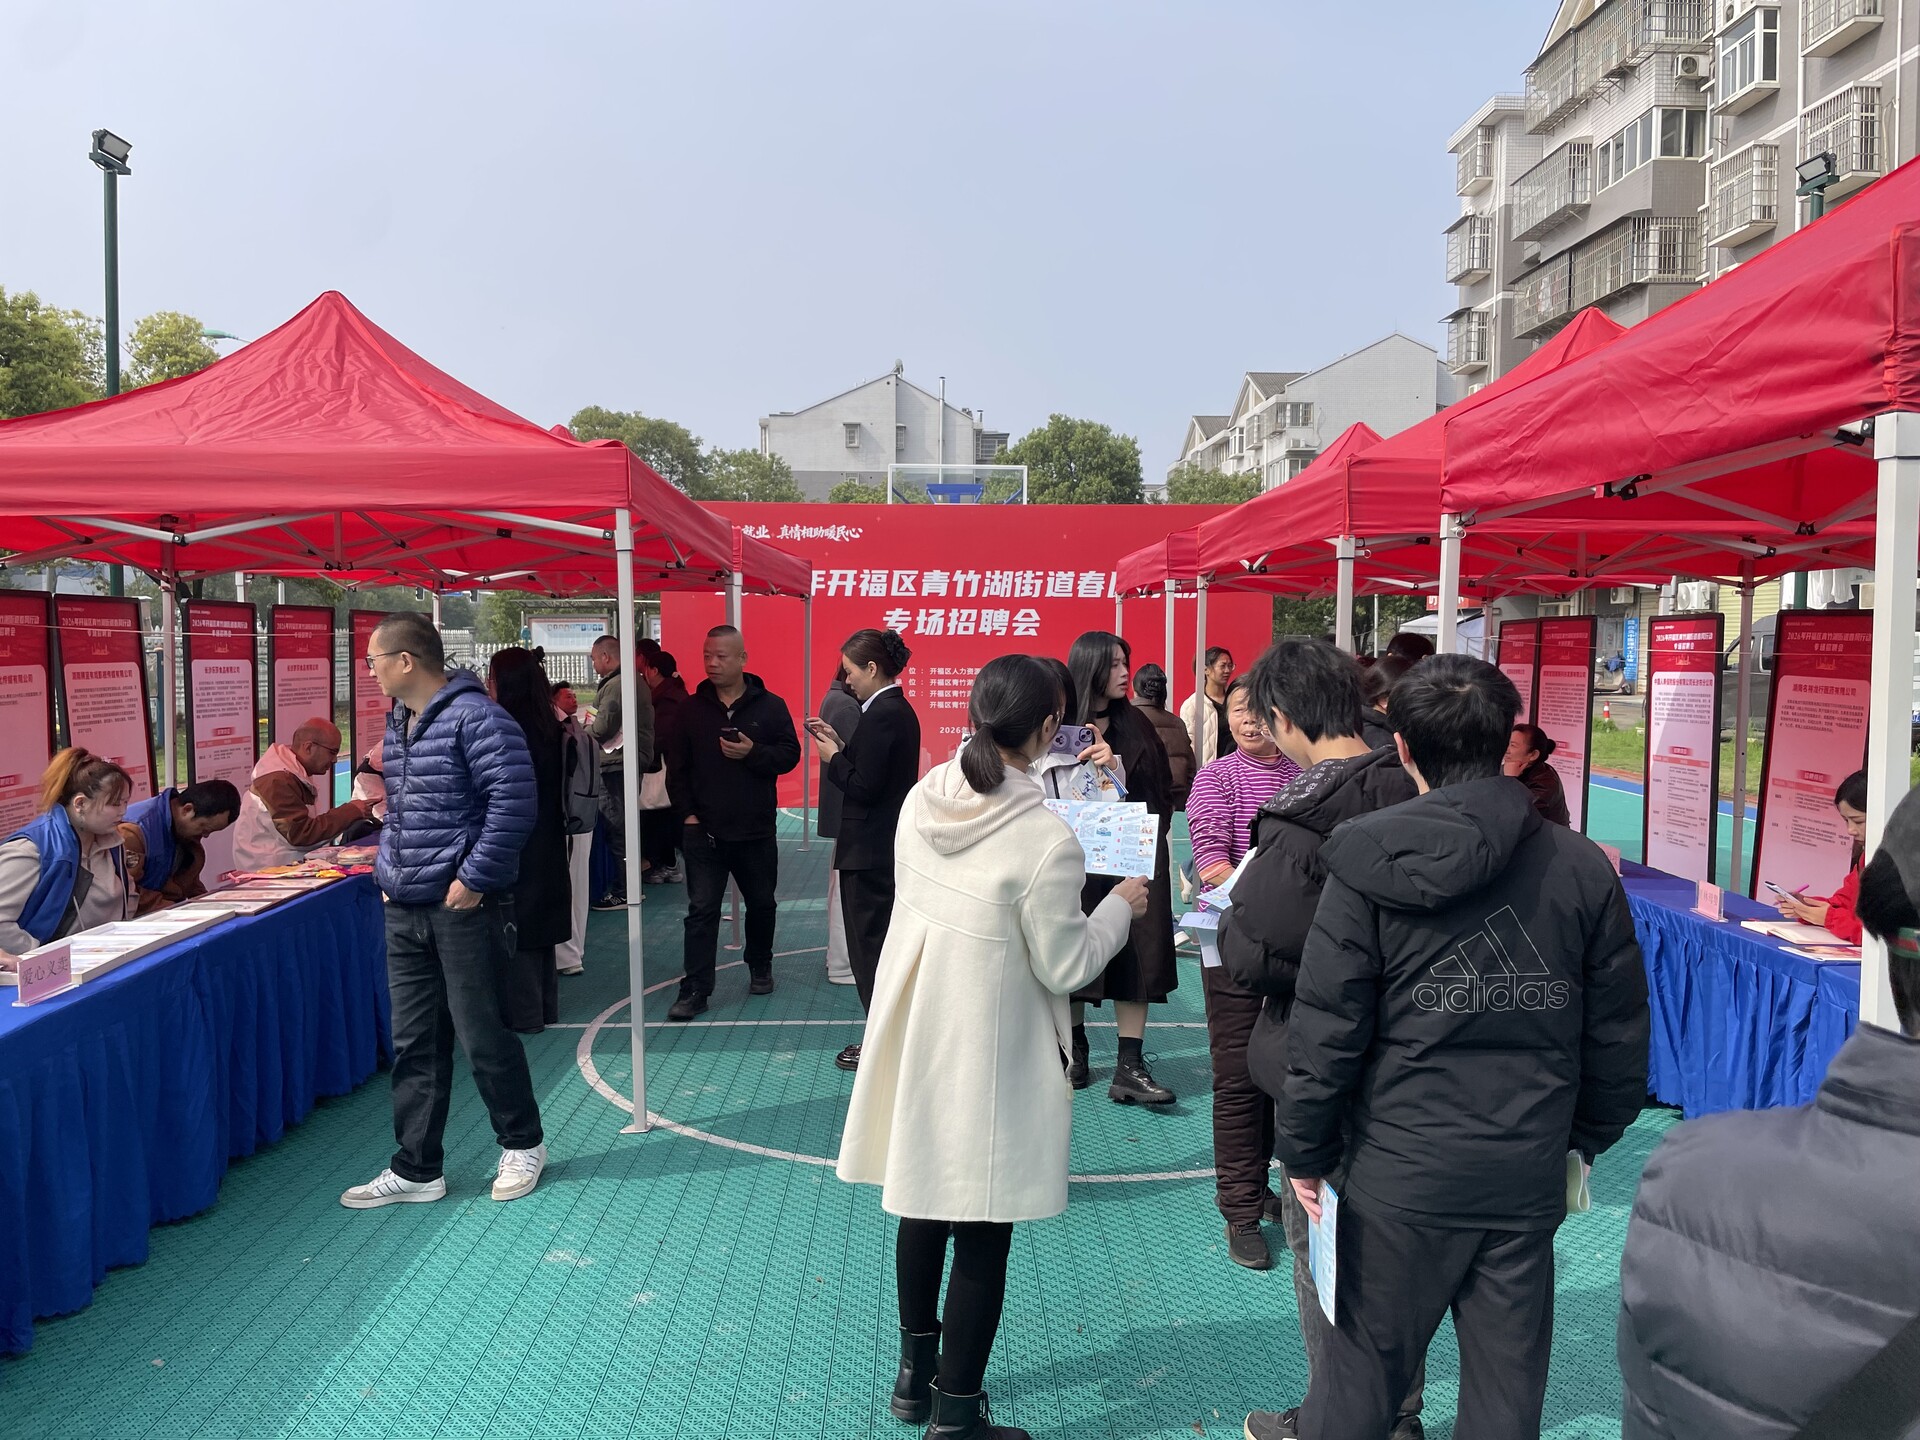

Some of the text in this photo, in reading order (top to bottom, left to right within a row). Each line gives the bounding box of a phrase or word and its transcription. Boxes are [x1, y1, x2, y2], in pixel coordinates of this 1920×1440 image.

[777, 525, 863, 542] 真情相助暖民心
[883, 608, 1041, 637] 专场招聘会
[929, 701, 968, 709] 开福区青竹
[22, 956, 69, 987] 爱心义卖
[1411, 973, 1570, 1014] adidas
